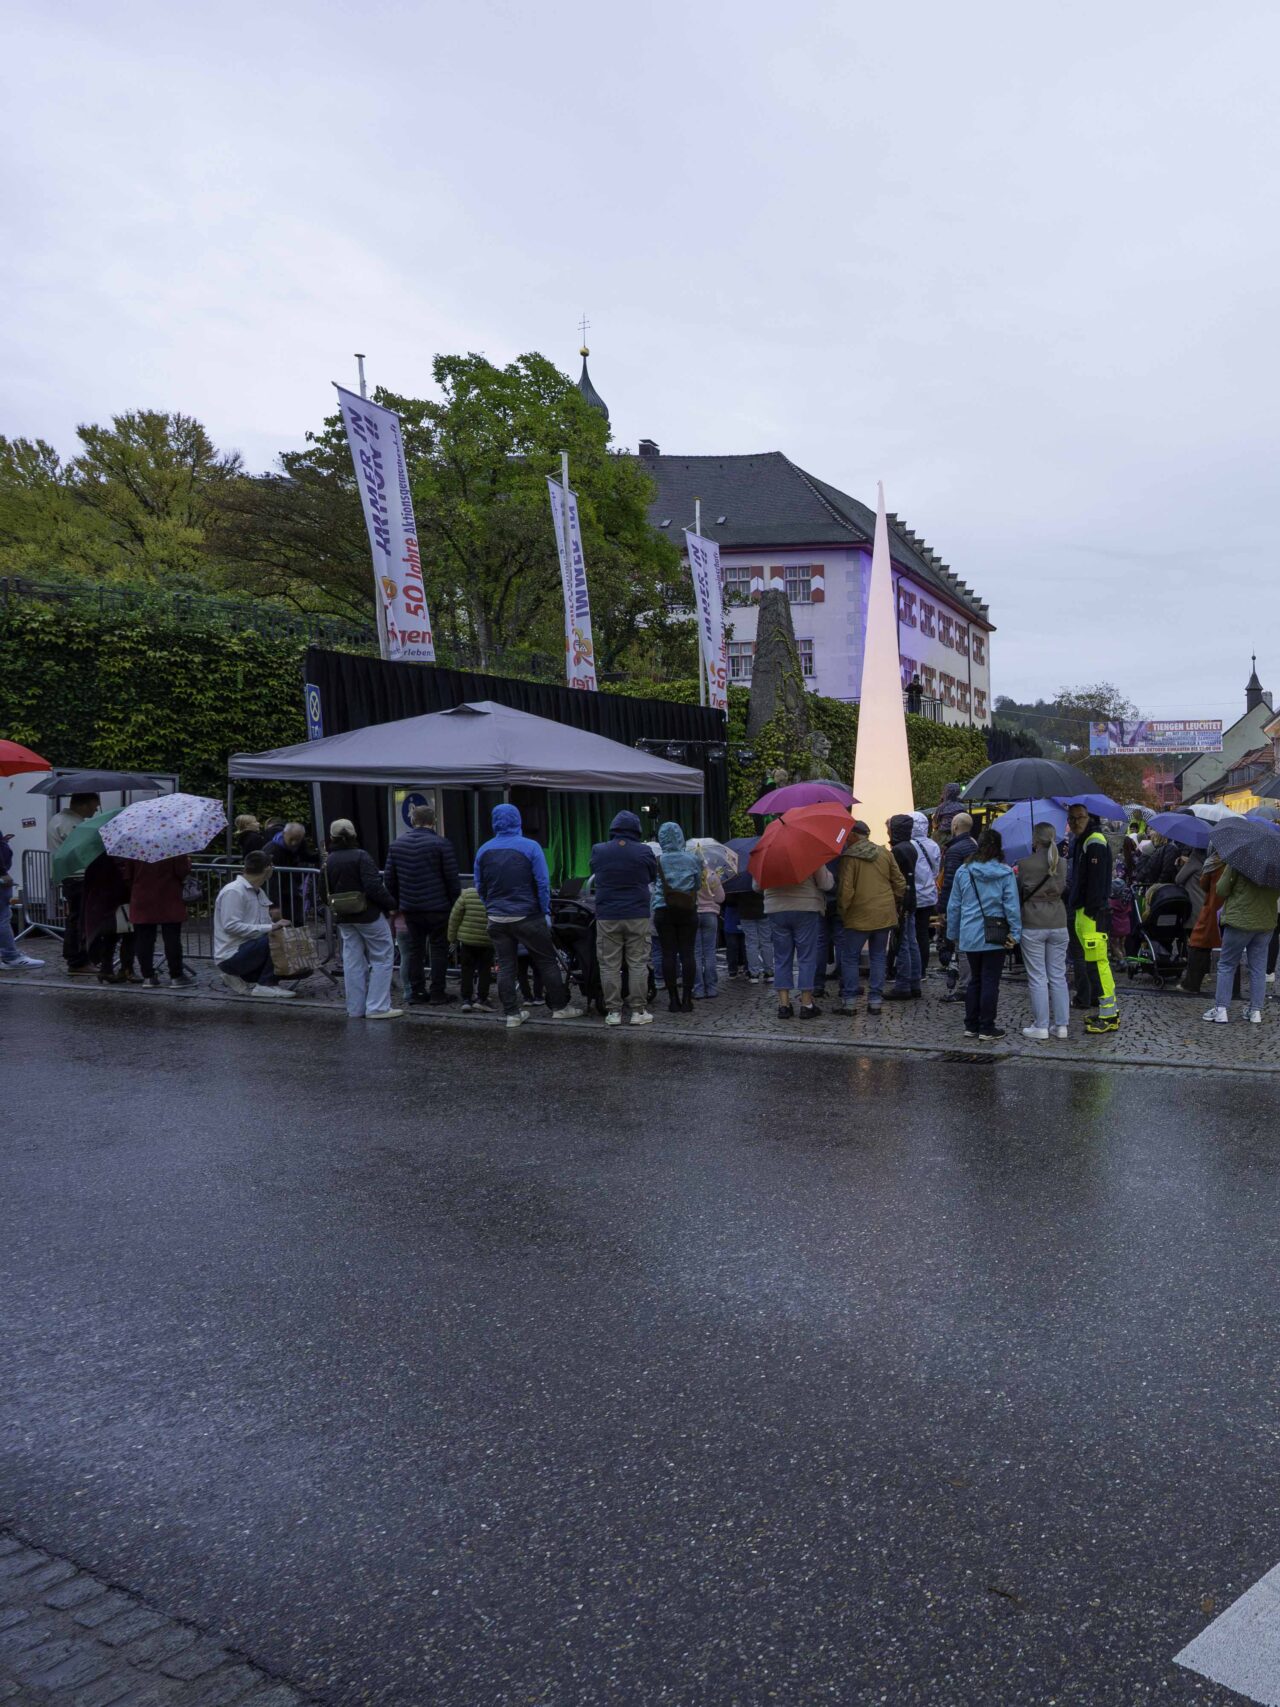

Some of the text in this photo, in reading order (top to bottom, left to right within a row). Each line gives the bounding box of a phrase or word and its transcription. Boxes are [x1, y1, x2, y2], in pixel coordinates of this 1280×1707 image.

[347, 406, 368, 443] IN
[402, 585, 426, 620] 50
[1153, 721, 1221, 731] TIENGEN LEUCHTET
